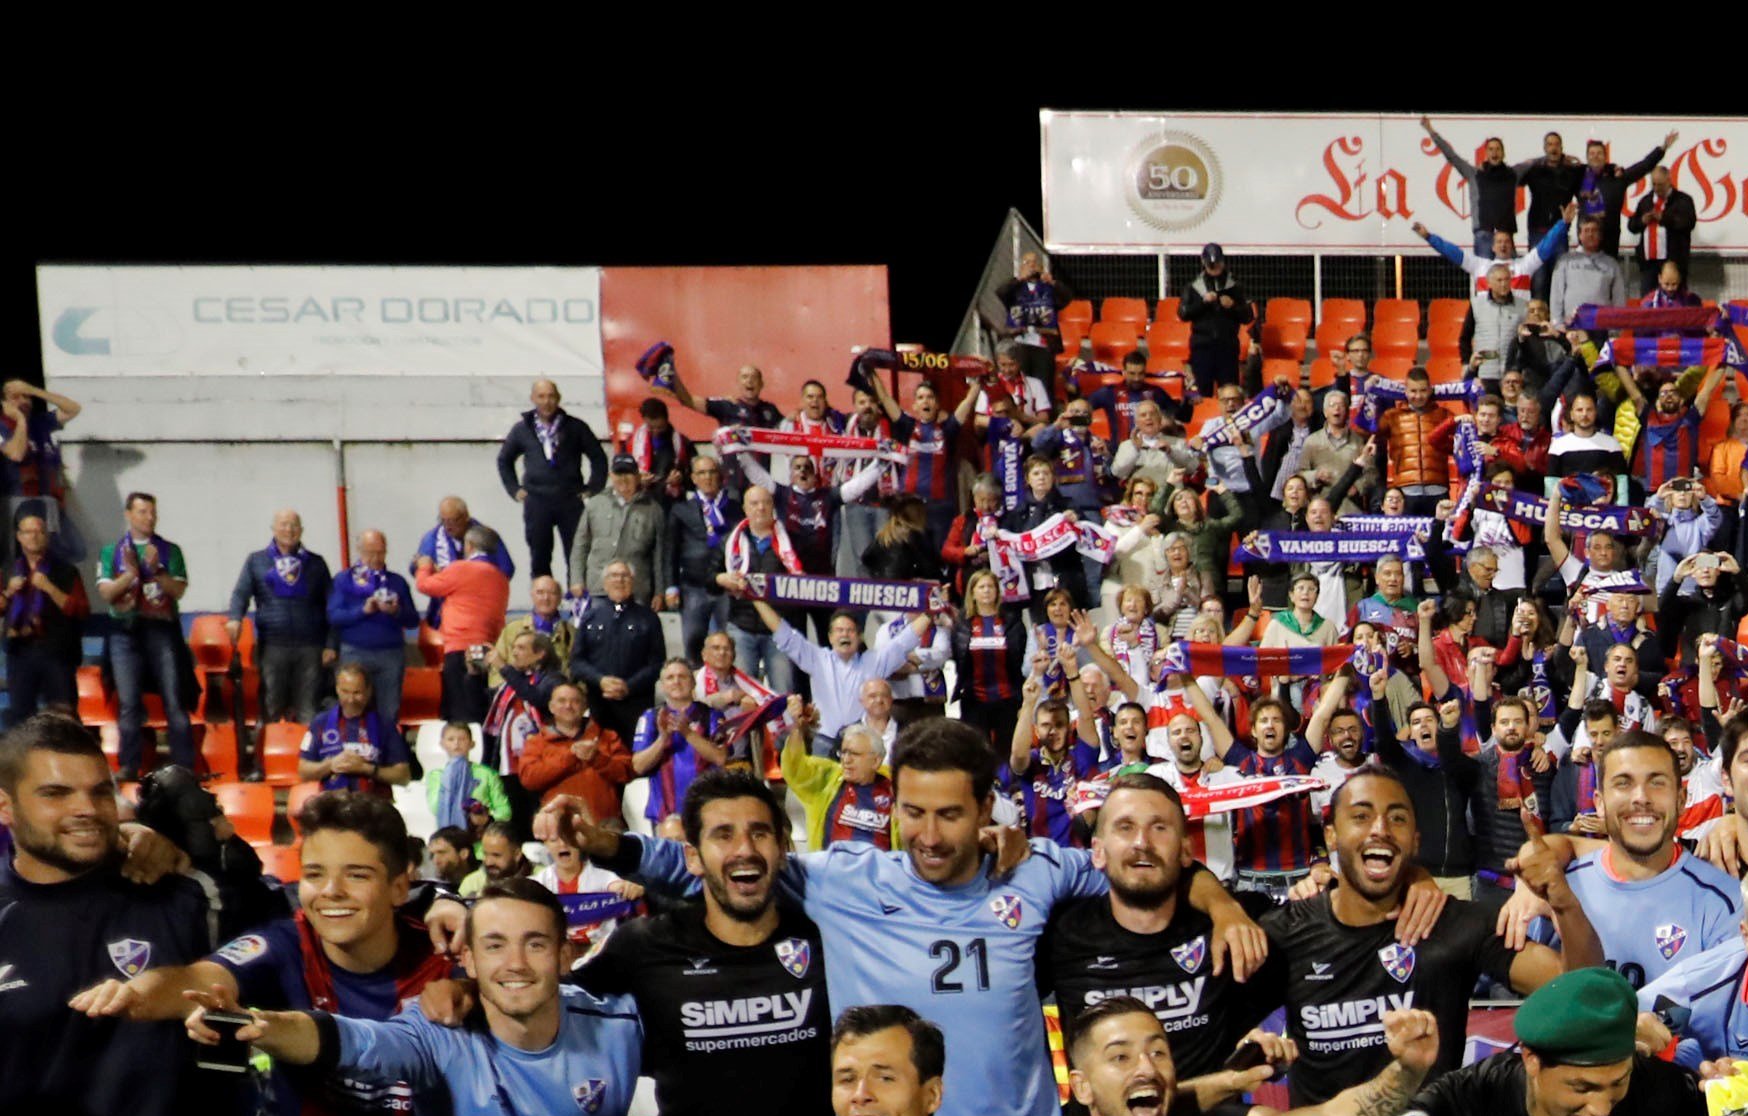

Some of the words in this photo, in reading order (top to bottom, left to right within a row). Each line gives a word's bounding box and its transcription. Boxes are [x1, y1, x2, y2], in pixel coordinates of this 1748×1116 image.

[1148, 164, 1199, 191] 50
[1296, 136, 1414, 229] La
[192, 297, 365, 324] CESAR
[380, 298, 595, 325] DORADO
[1004, 442, 1018, 493] VAMOS
[1278, 540, 1336, 554] VAMOS
[1337, 539, 1400, 553] HUESCA
[775, 575, 840, 603] VAMOS
[849, 581, 919, 609] HUESCA
[929, 937, 991, 995] 21
[686, 1026, 817, 1054] supermercados
